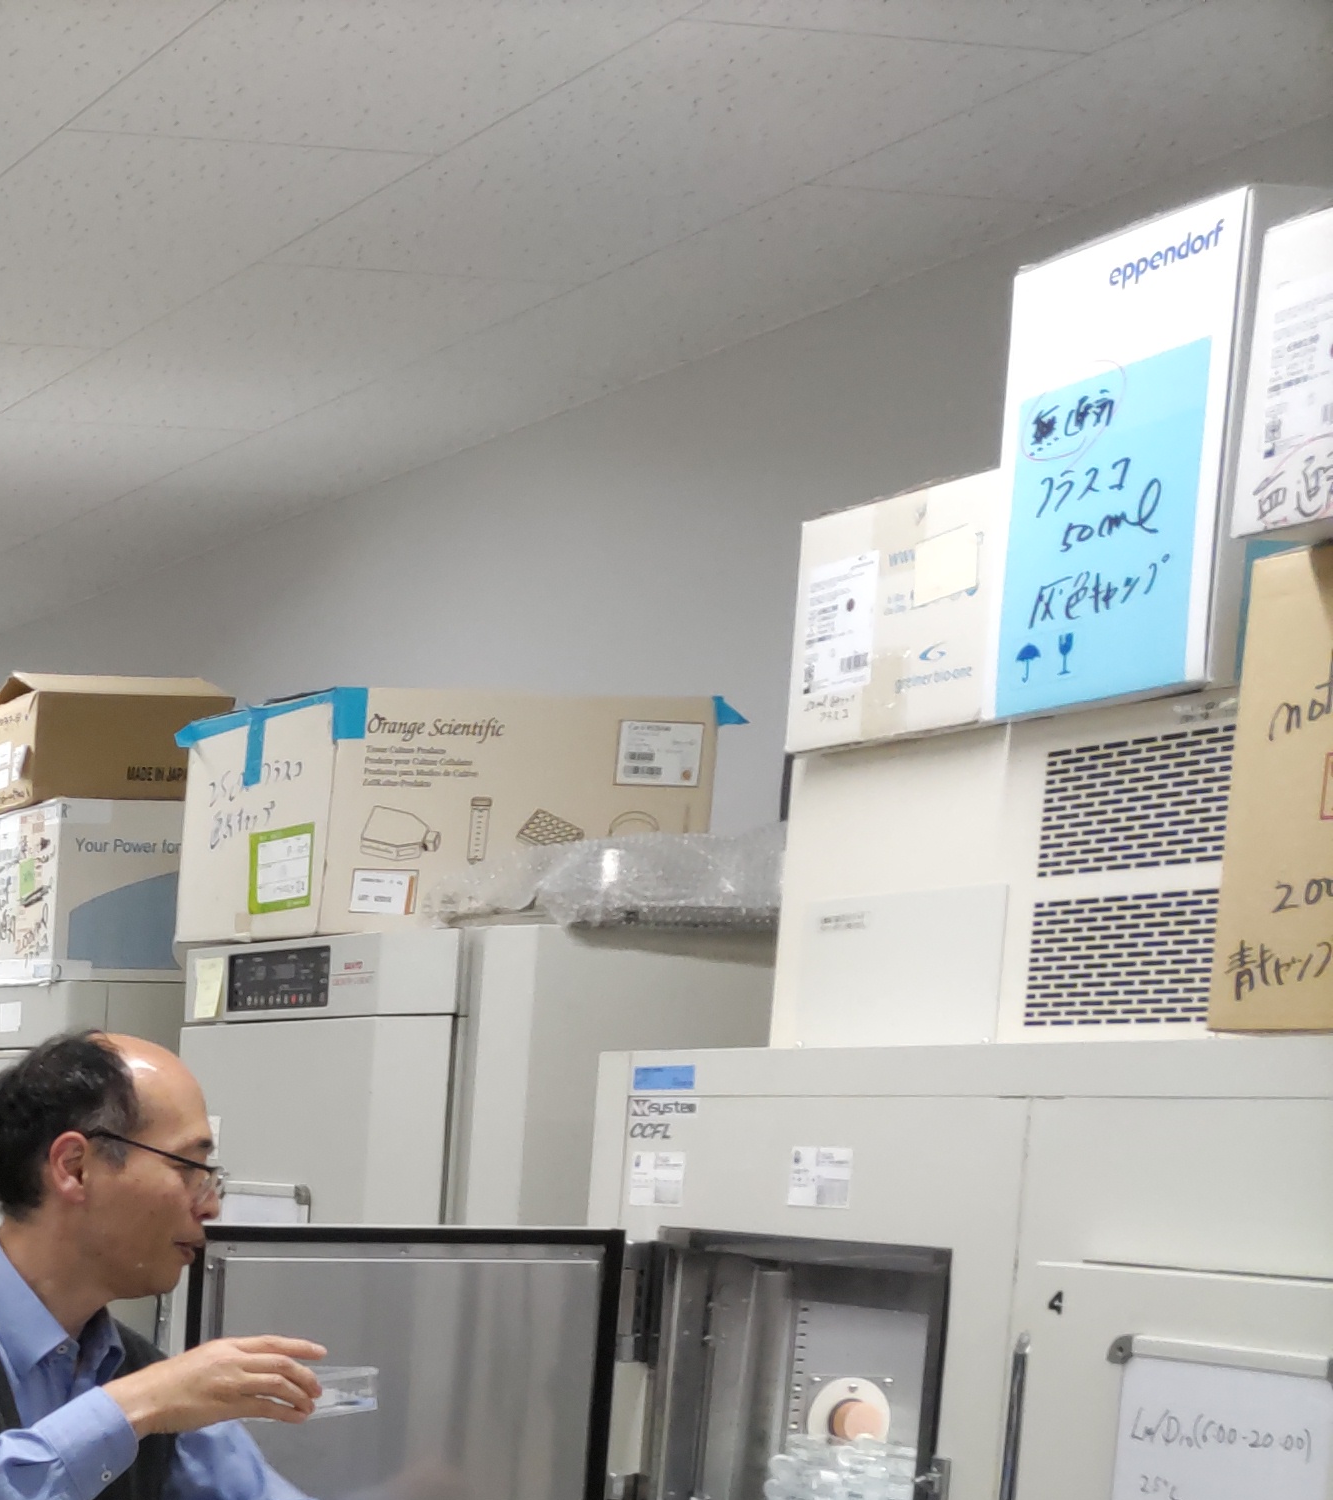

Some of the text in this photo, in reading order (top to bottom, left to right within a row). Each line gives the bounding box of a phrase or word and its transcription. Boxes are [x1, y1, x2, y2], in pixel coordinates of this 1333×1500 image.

[1108, 218, 1225, 288] eppendorf
[1035, 457, 1131, 518] フラスコ
[367, 713, 506, 744] Orange Scientific
[166, 767, 187, 782] JAP
[75, 837, 182, 854] Your Power for
[629, 1122, 671, 1139] CCFL
[1047, 1291, 1064, 1315] 4
